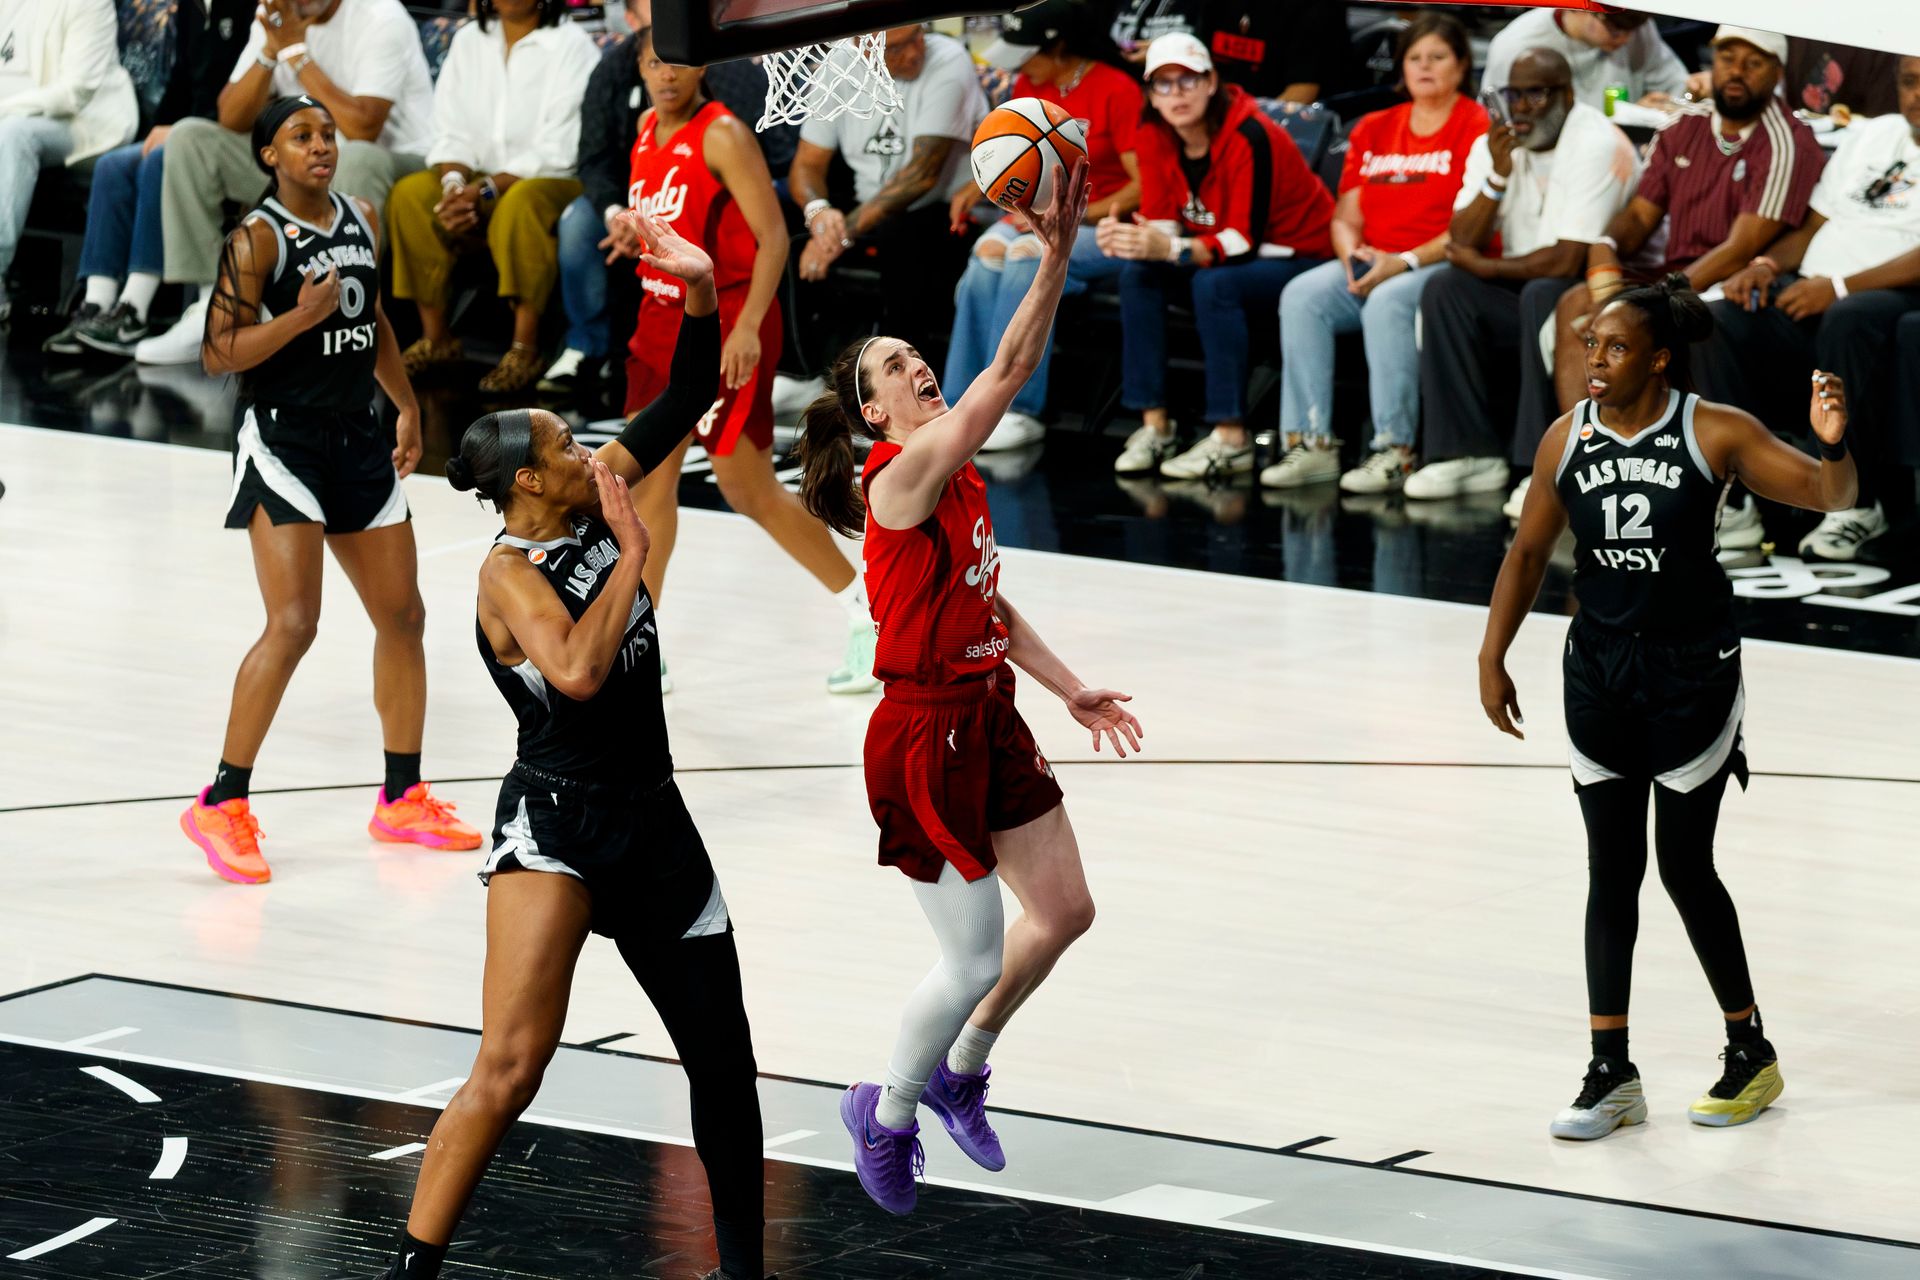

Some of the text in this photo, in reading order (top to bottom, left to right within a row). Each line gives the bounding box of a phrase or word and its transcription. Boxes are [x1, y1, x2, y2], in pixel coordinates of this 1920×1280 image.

[339, 276, 365, 319] 0
[323, 322, 377, 356] IPSY
[1654, 434, 1680, 449] ally
[1574, 457, 1683, 494] LAS VEGAS
[1601, 493, 1653, 540] 12
[1592, 547, 1666, 572] IPSY
